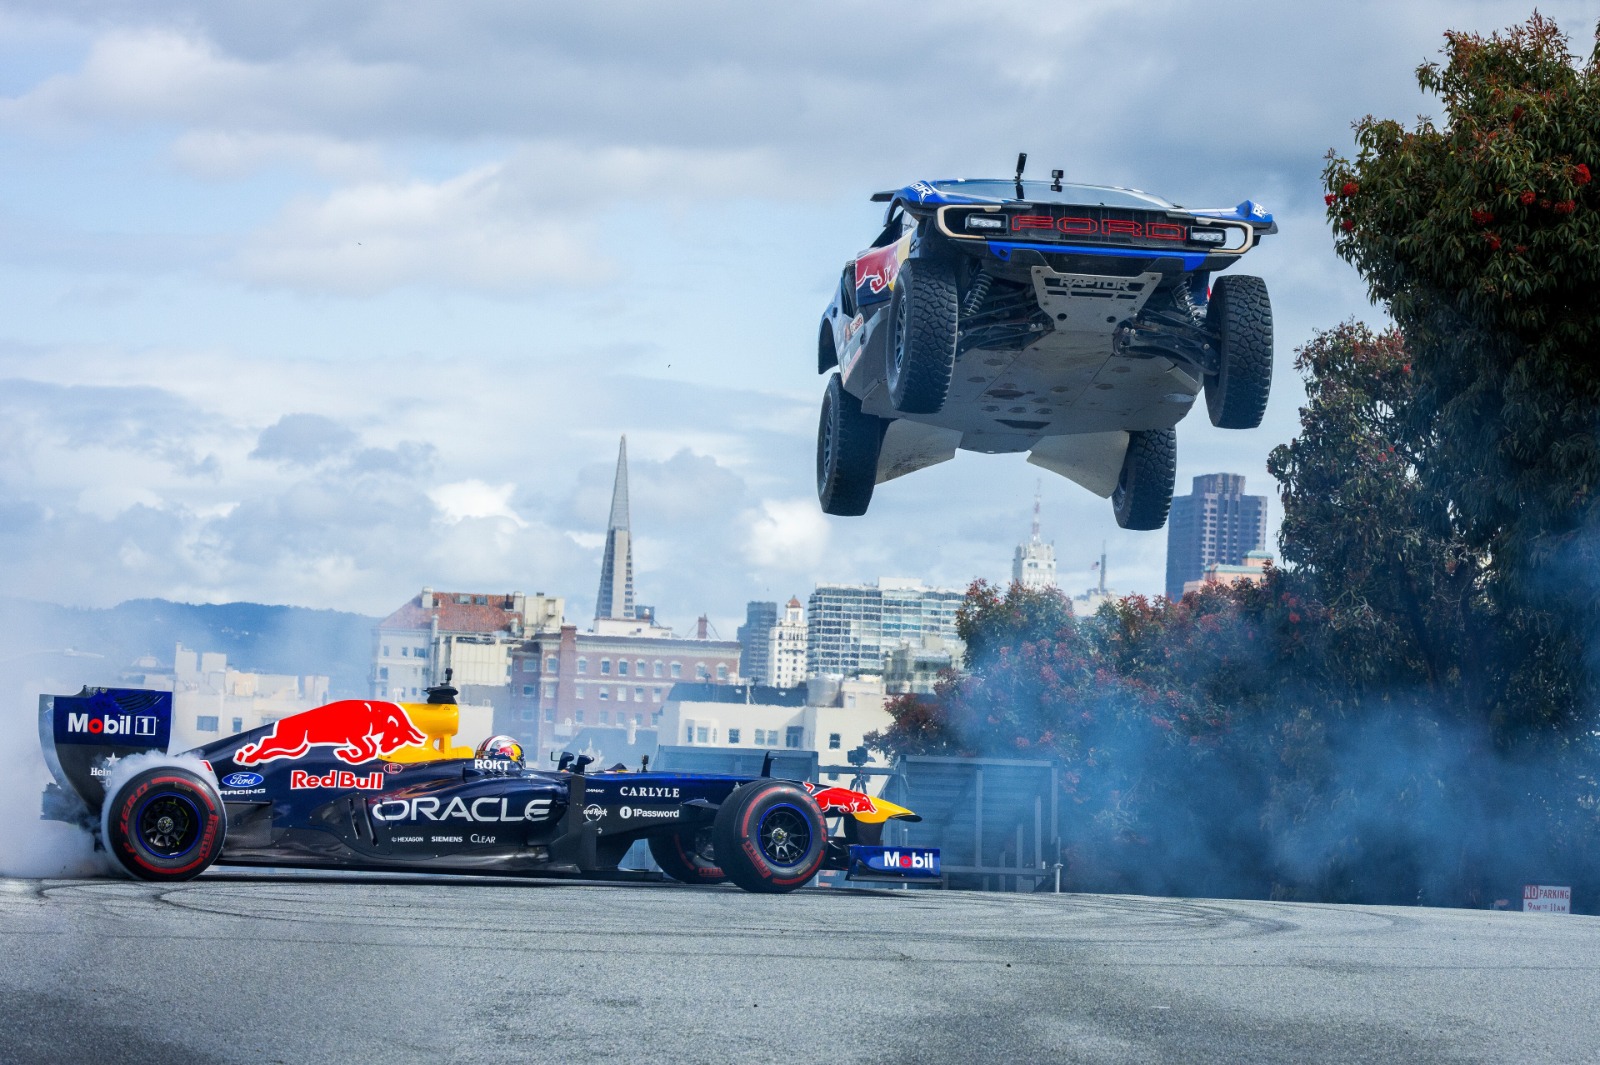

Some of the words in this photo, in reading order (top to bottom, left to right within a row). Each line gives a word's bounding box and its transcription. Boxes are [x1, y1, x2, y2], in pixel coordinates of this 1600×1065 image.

[1012, 215, 1187, 241] FORD
[1059, 278, 1130, 291] RAPTOR
[67, 713, 131, 735] Mobil
[474, 759, 511, 770] ROKT
[90, 767, 112, 776] Hein
[229, 774, 256, 785] Ford
[290, 770, 337, 790] Red
[338, 772, 384, 791] Bull
[619, 786, 680, 798] CARLYLE
[372, 797, 553, 822] ORACLE
[632, 808, 680, 818] 1Password
[431, 835, 463, 843] SIEMENS
[884, 851, 933, 869] Mobil
[1524, 886, 1538, 899] NO
[1539, 889, 1569, 899] PARKING
